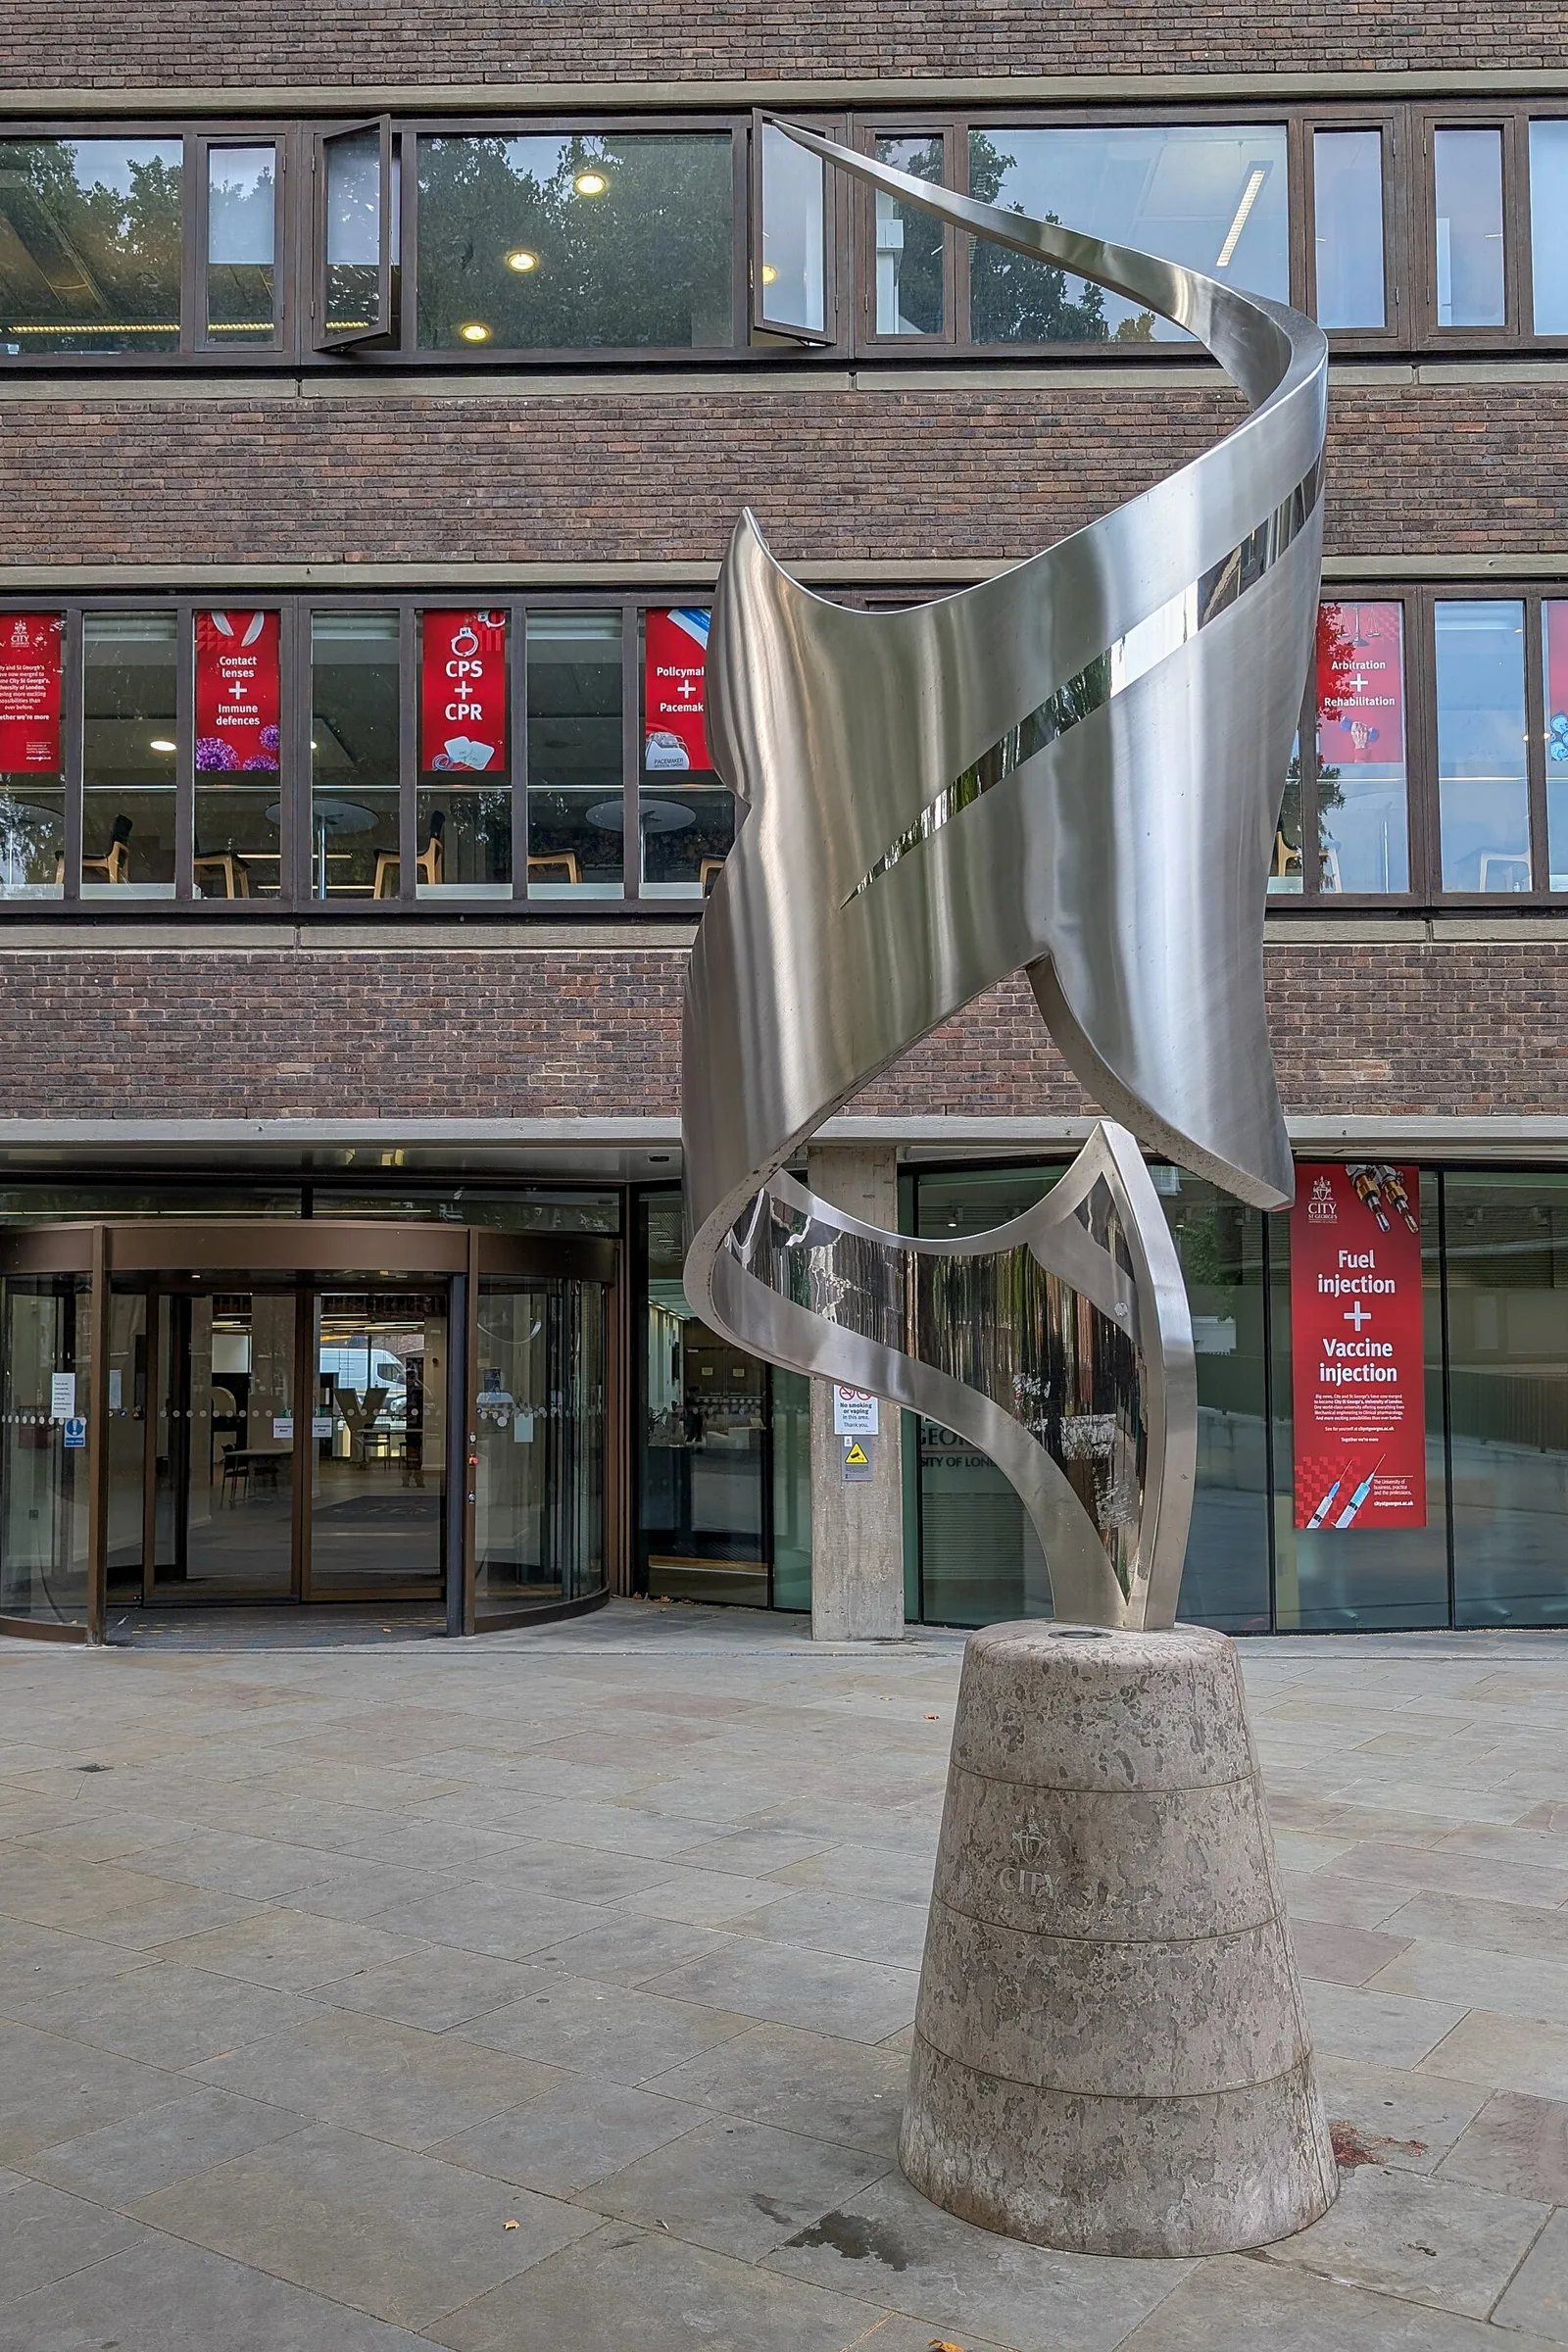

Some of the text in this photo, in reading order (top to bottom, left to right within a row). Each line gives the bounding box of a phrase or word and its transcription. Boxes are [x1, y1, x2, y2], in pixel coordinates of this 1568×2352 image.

[219, 656, 257, 666] Contact
[1331, 660, 1386, 670] Arbitration
[222, 668, 254, 678] lenses
[445, 660, 483, 678] CPS
[1324, 696, 1395, 706] Rehabilitation
[218, 704, 258, 713] Immune
[445, 704, 483, 721] CPR
[660, 703, 704, 712] Pacemak
[216, 715, 260, 726] defences
[1308, 1203, 1336, 1214] CITY
[1338, 1250, 1375, 1268] Fuel
[1318, 1274, 1395, 1298] injection
[1323, 1338, 1393, 1357] Vaccine
[1319, 1363, 1397, 1386] injection
[946, 1457, 962, 1467] OF
[1000, 1867, 1061, 1899] CITY
